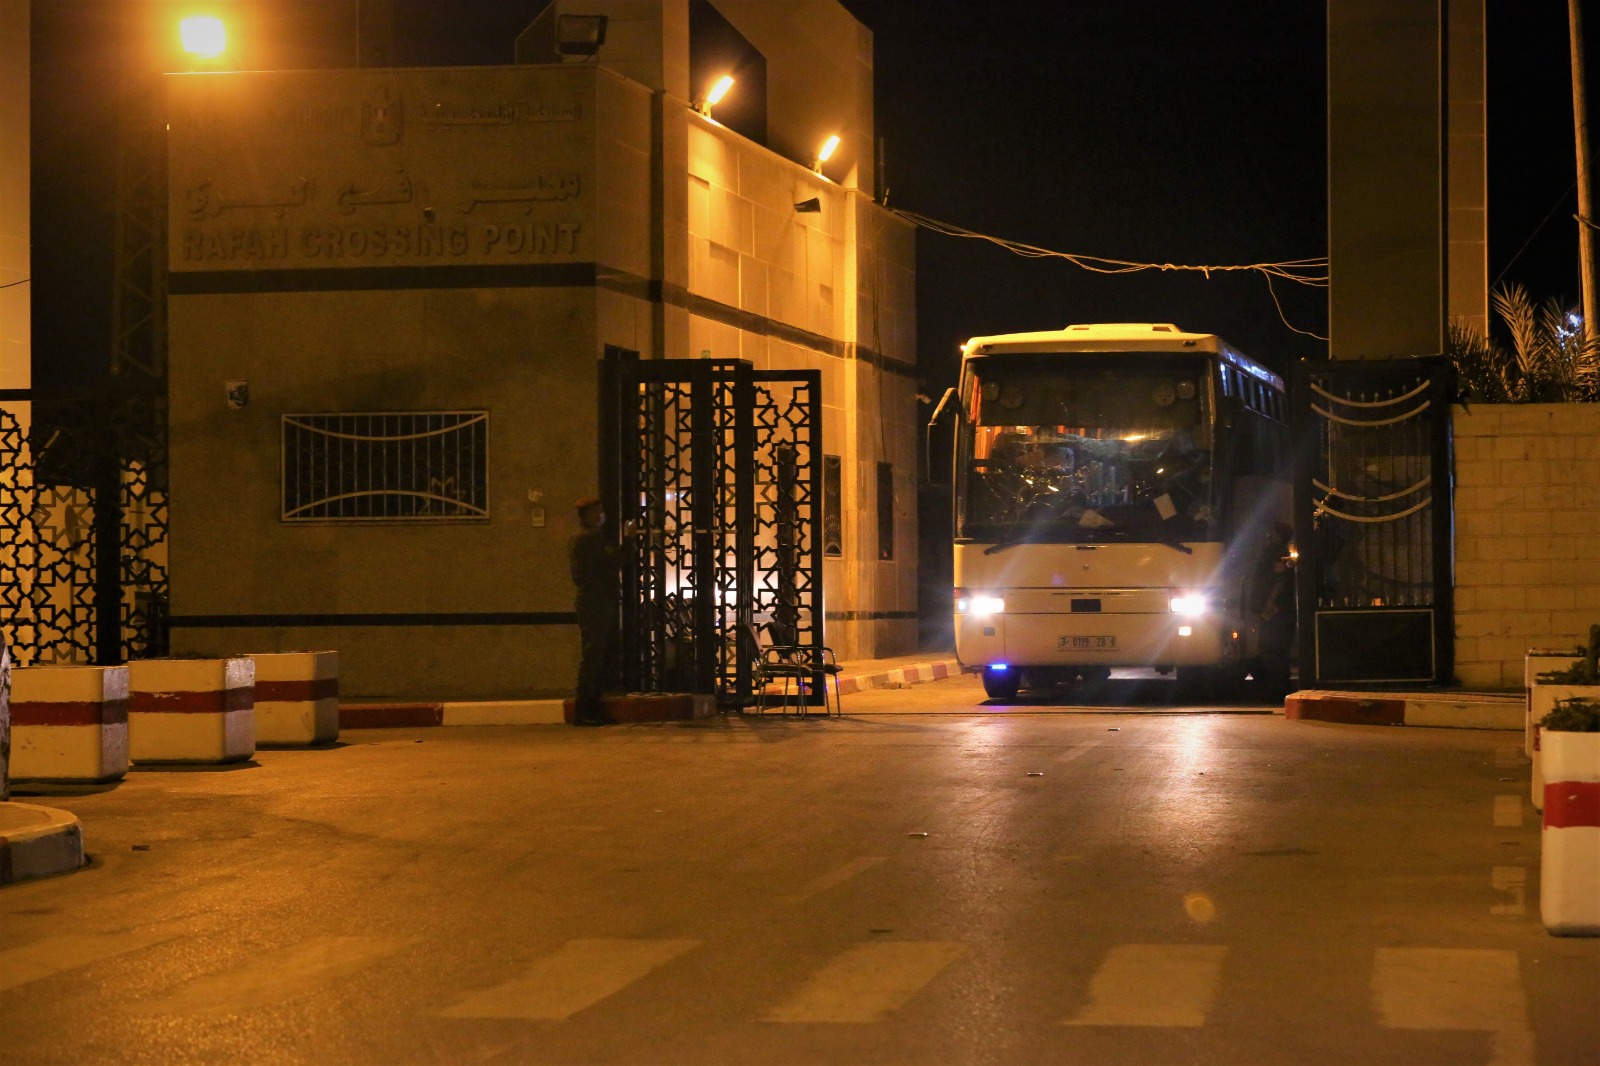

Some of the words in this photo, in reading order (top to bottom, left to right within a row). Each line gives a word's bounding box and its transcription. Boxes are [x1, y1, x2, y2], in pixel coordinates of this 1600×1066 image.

[458, 174, 581, 216] معبر
[184, 229, 289, 261] RAFAH
[304, 225, 469, 259] CROSSING
[482, 223, 582, 256] POINT
